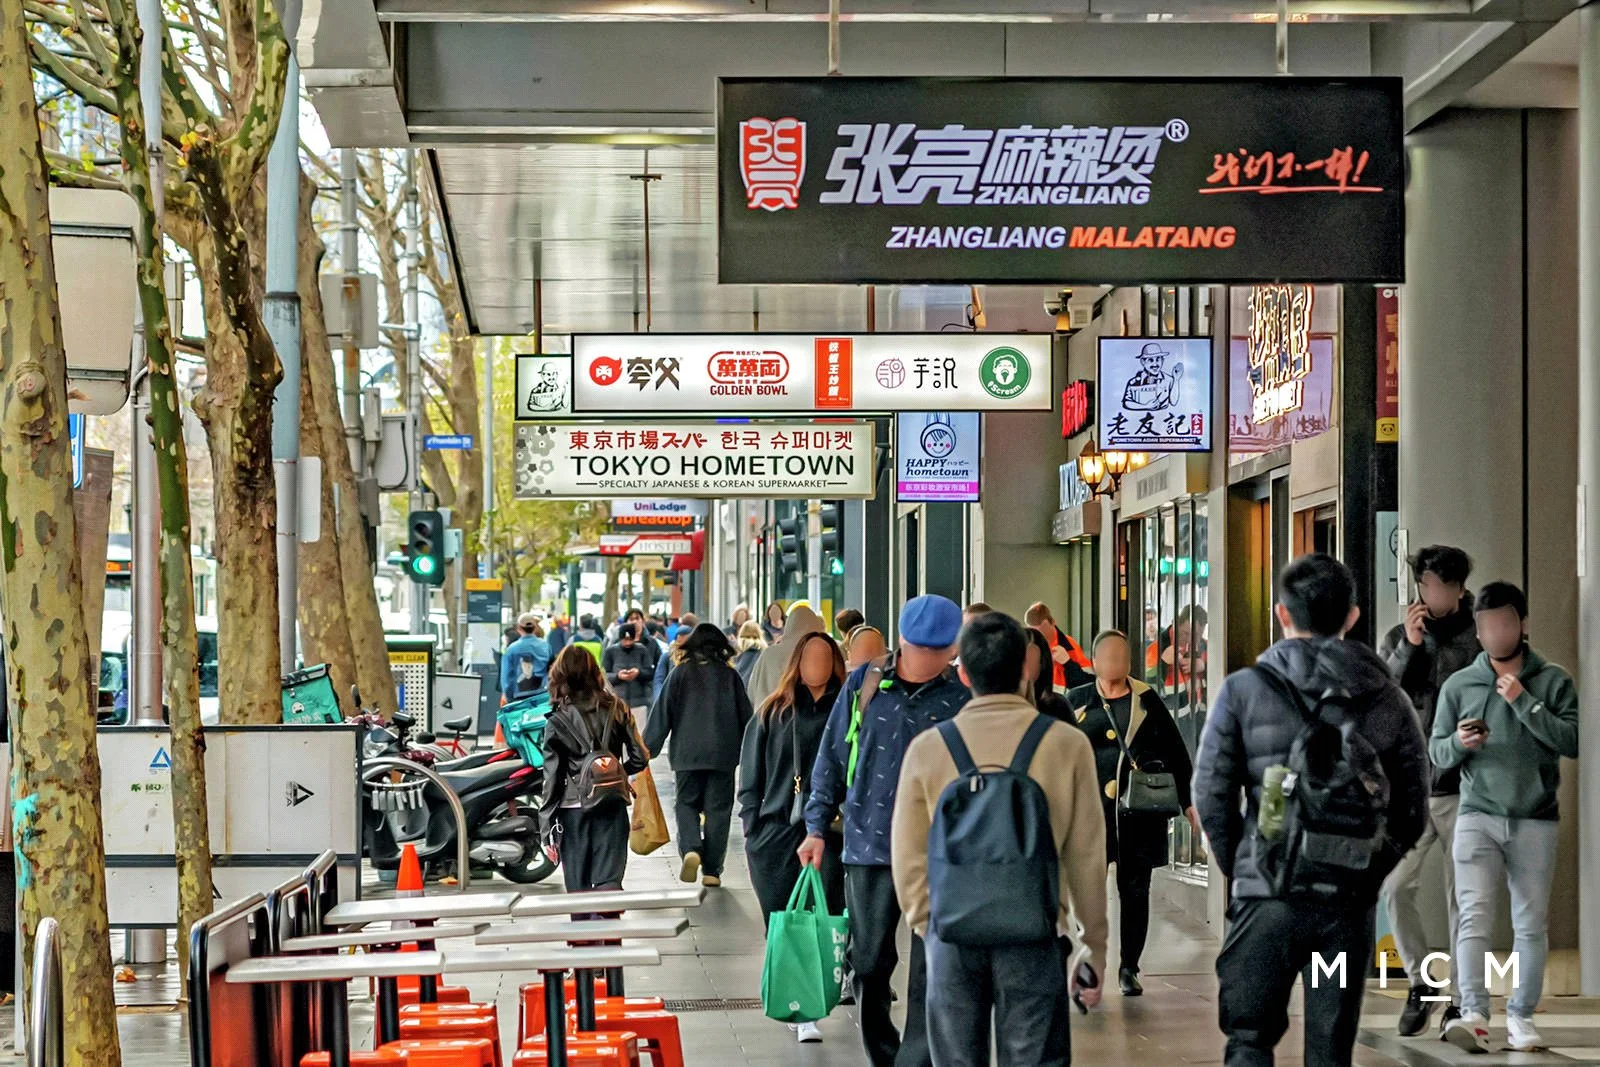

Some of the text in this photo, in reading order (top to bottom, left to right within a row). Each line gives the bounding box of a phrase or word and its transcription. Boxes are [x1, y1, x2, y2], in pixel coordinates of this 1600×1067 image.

[819, 123, 1165, 205] 张亮麻辣烫
[975, 186, 1150, 205] ZHANGLIANG
[885, 226, 1236, 248] ZHANGLIANG MALATANG
[626, 356, 680, 391] 夸父
[710, 385, 788, 395] GOLDEN BOWL
[1107, 412, 1191, 436] 老友記
[721, 431, 760, 450] 한국
[770, 431, 853, 450] 슈퍼마켓
[570, 455, 854, 475] TOKYO HOMETOWN
[905, 459, 948, 467] HAPPY
[906, 467, 969, 476] hometown
[599, 480, 827, 488] SPECIALTY JAPANESE & KOREAN SUPERMARKET
[634, 502, 687, 511] UniLodge
